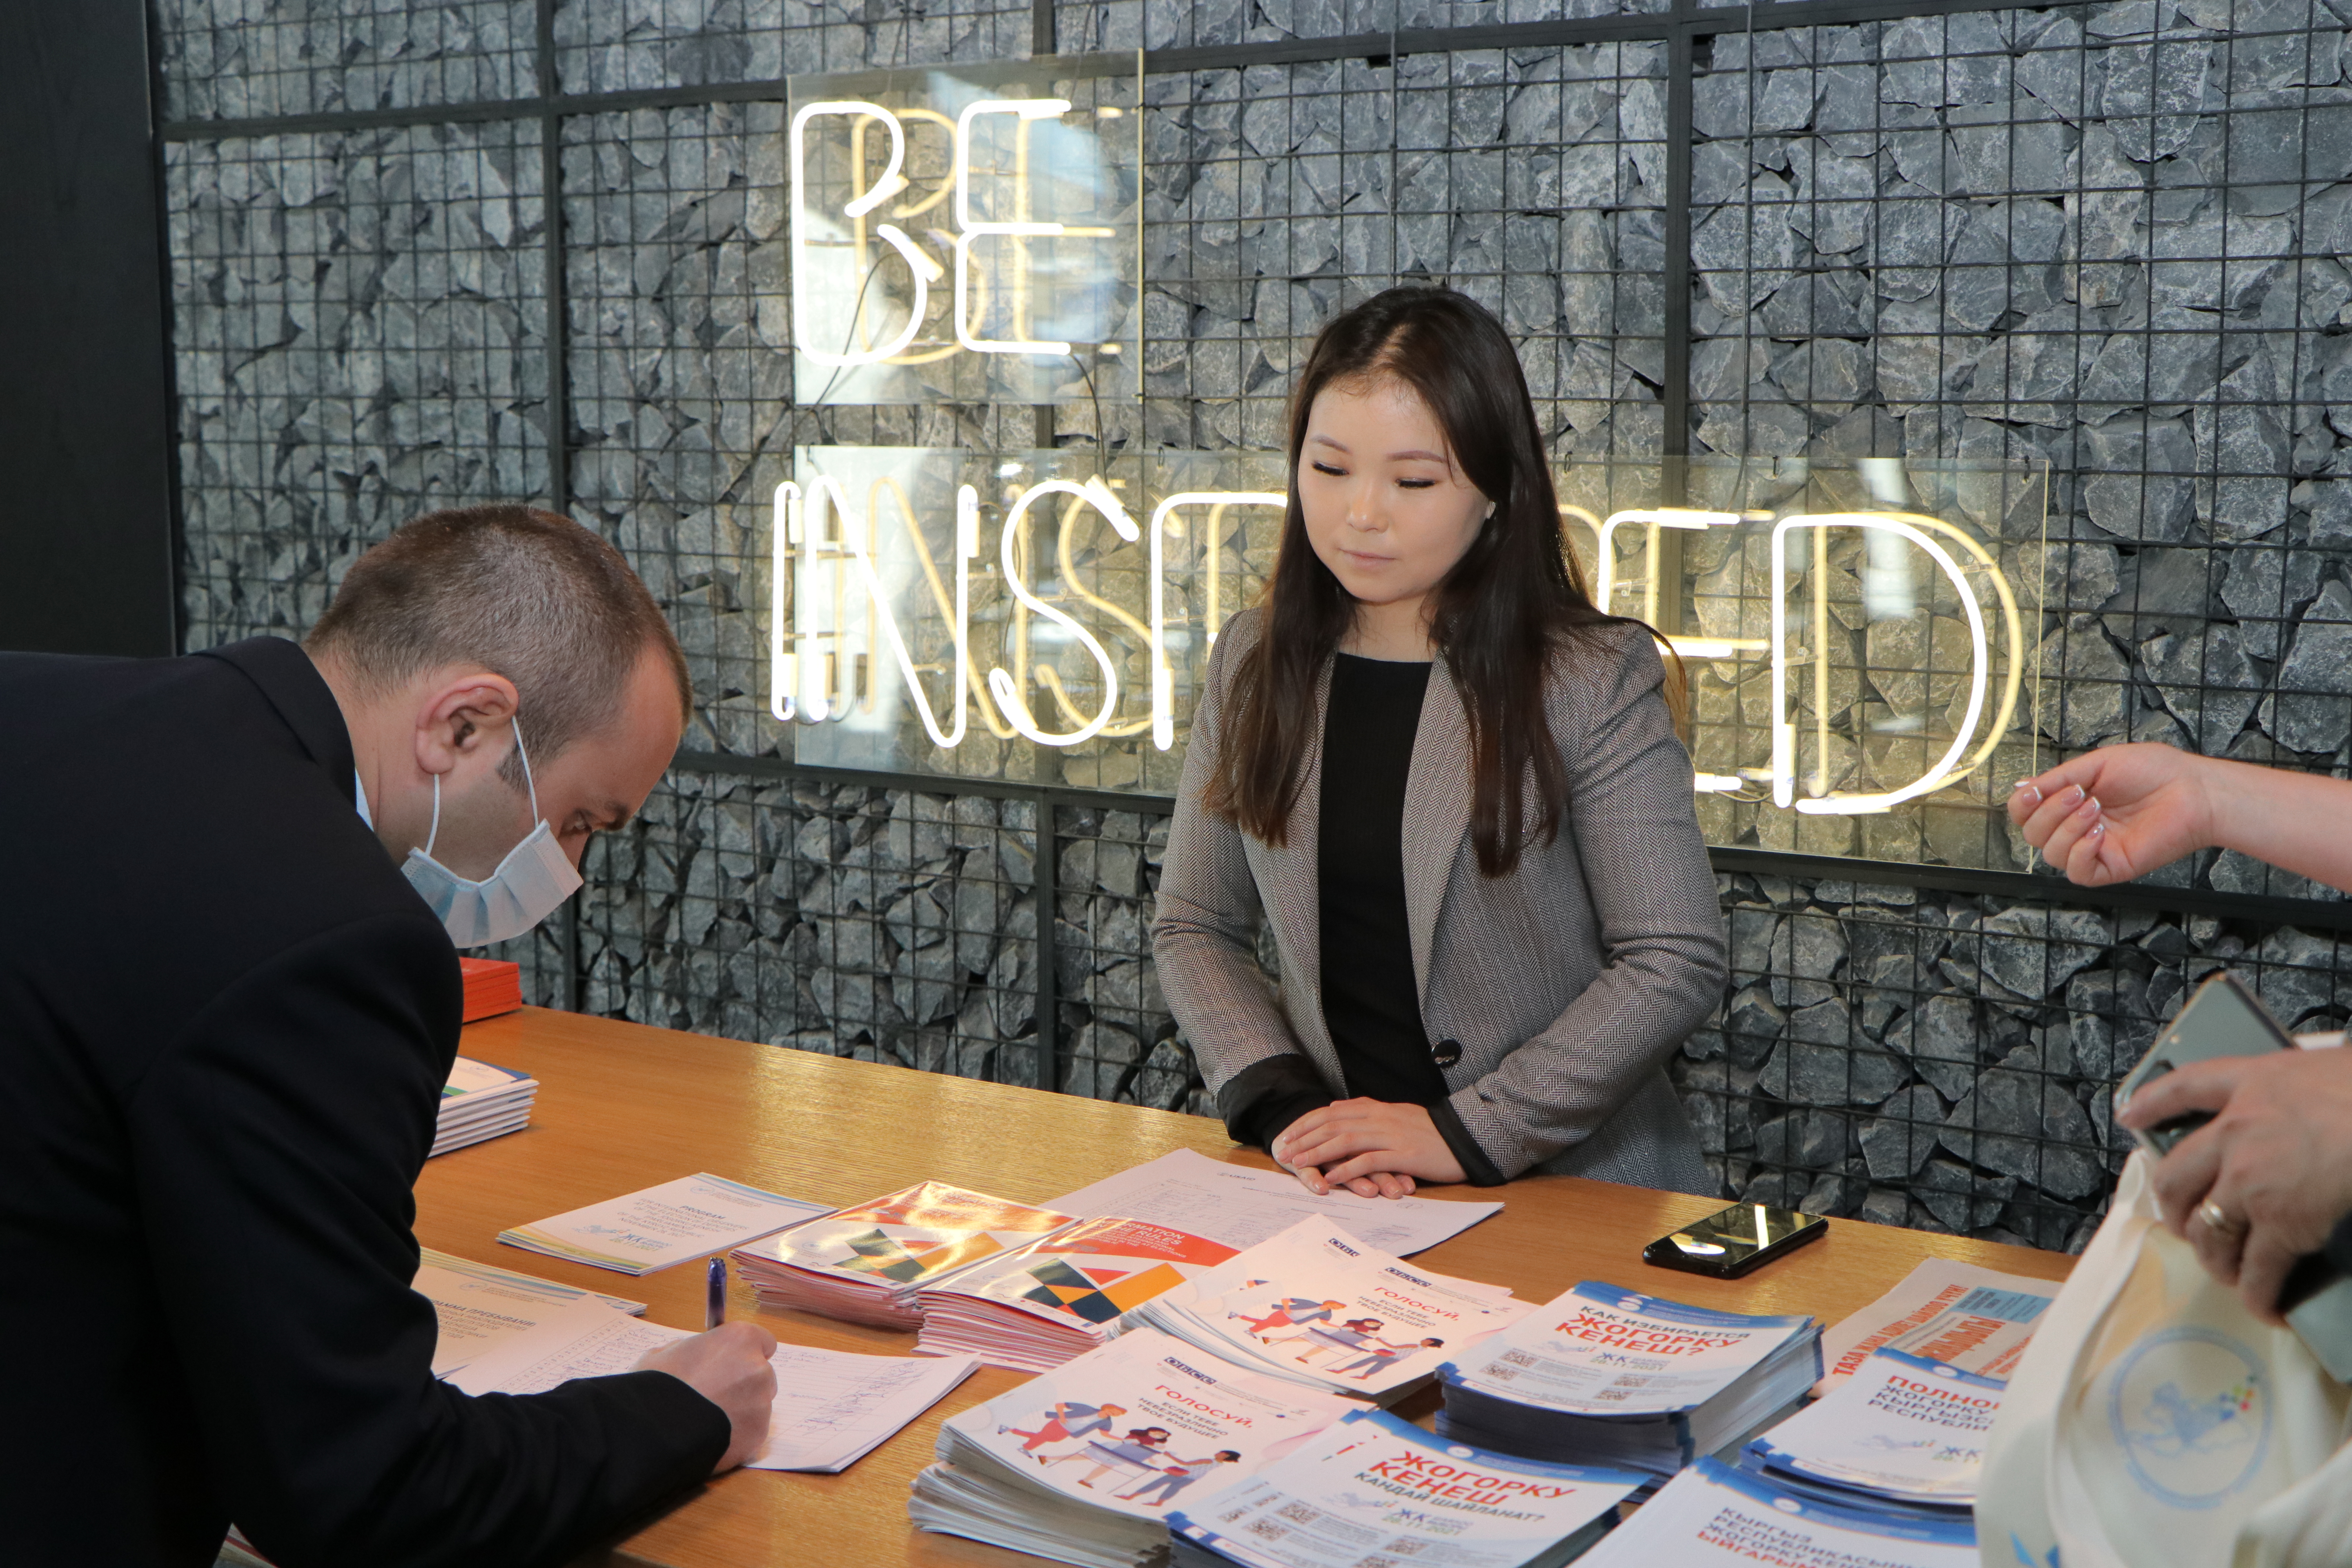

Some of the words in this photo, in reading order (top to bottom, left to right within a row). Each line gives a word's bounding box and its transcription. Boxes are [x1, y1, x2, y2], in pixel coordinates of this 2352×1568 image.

[791, 99, 1072, 367] BE
[679, 1205, 726, 1220] PROGRAM
[1135, 1230, 1182, 1245] RULES
[1150, 1245, 1187, 1258] ELECTIONS
[1356, 1300, 1380, 1314] ТВОЕ
[1380, 1311, 1428, 1329] БУДУЩЕЕ
[1357, 1296, 1436, 1327] НЕБЕЗРАЗЛИЧНО
[1374, 1287, 1460, 1321] ГОЛОСУЙ,
[1379, 1299, 1404, 1311] ЕСЛИ
[1406, 1309, 1430, 1319] ТЕБЕ
[1555, 1322, 1705, 1356] КЕНЕШ?
[1569, 1314, 1742, 1348] ЖОГОРКУ
[1581, 1305, 1618, 1321] КАК
[1622, 1318, 1751, 1339] ИЗБИРАЕТСЯ
[1595, 1352, 1632, 1363] ЖК
[1832, 1352, 1871, 1376] ТАЗА
[1138, 1398, 1228, 1436] НЕБЕЗРАЗЛИЧНО
[1154, 1385, 1253, 1428] ГОЛОСУЙ,
[1161, 1402, 1191, 1416] ЕСЛИ
[1193, 1414, 1220, 1427] ТЕБЕ
[1882, 1385, 1991, 1415] ЖОГОРКУ
[1137, 1403, 1164, 1419] ТВОЕ
[1165, 1416, 1220, 1439] БУДУЩЕЕ
[1390, 1450, 1576, 1499] ЖОГОРКУ
[1354, 1472, 1430, 1503] КАНДАЙ
[1429, 1494, 1545, 1522] ШАЙЛАНАТ?
[1392, 1508, 1432, 1522] ЖК
[1721, 1507, 1812, 1542] КЫРГЫЗ
[1705, 1524, 1806, 1559] ЖОГОРКУ
[1713, 1515, 1917, 1568] РЕСПУБЛИКАСЫН
